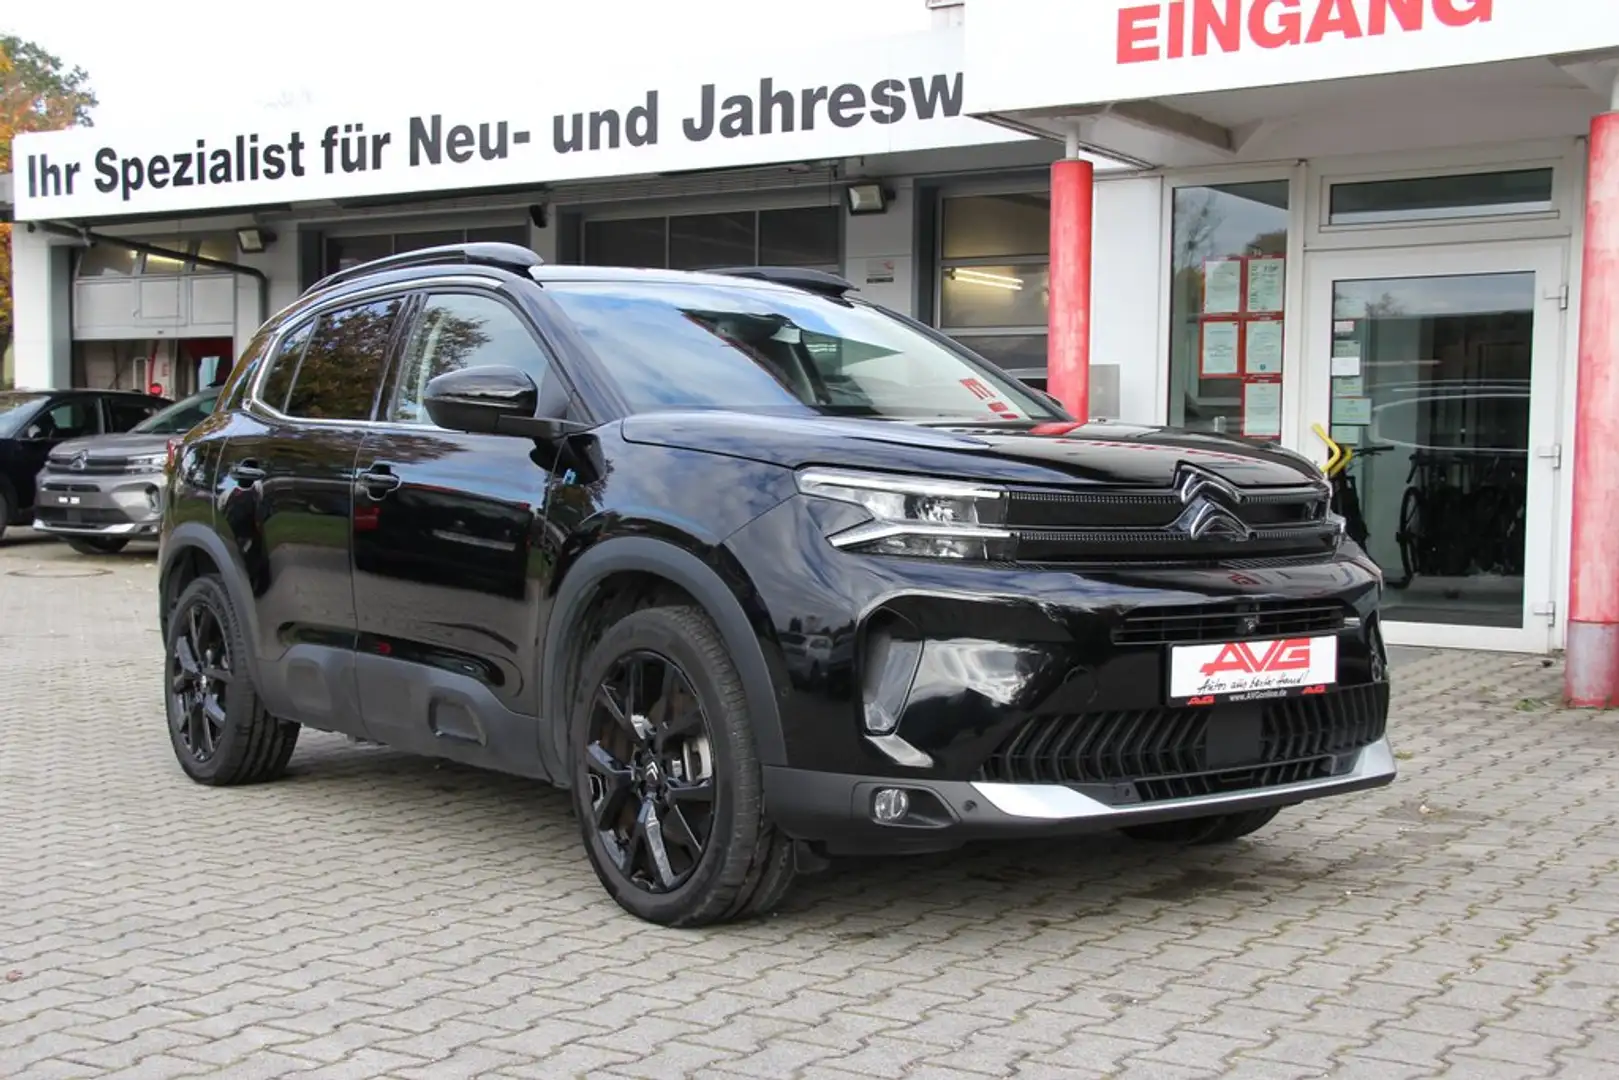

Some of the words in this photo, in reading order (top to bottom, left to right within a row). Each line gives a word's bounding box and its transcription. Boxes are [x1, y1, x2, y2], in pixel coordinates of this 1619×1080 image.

[27, 153, 80, 197] Ihr
[94, 131, 305, 200] Spezialist
[321, 123, 391, 173] für
[409, 114, 531, 167] Neu-
[553, 90, 659, 154] und
[682, 71, 964, 142] Jahresw
[1200, 638, 1310, 676] AVG
